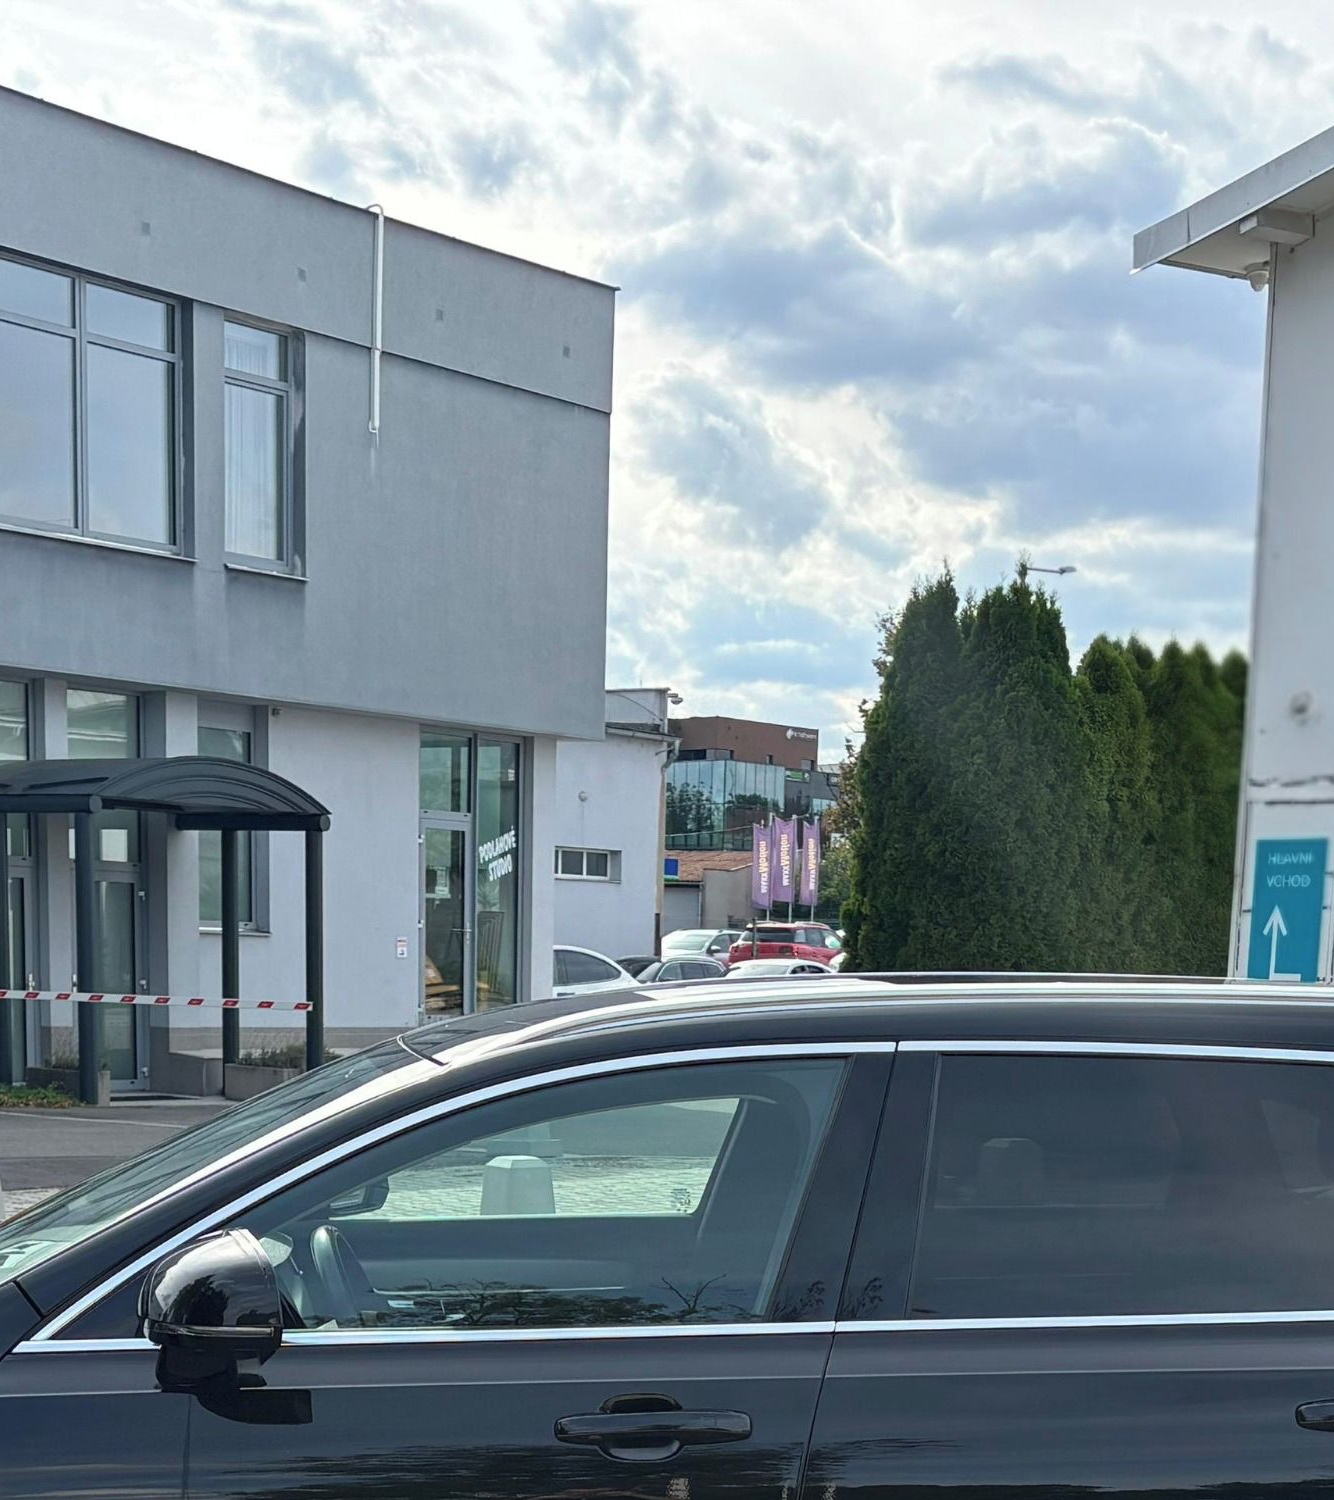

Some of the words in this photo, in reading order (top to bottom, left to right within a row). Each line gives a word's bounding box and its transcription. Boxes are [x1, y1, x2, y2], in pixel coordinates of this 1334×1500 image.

[1268, 848, 1314, 865] HLAVNÍ
[489, 853, 513, 882] STUDIO
[1267, 874, 1312, 888] VCHOD
